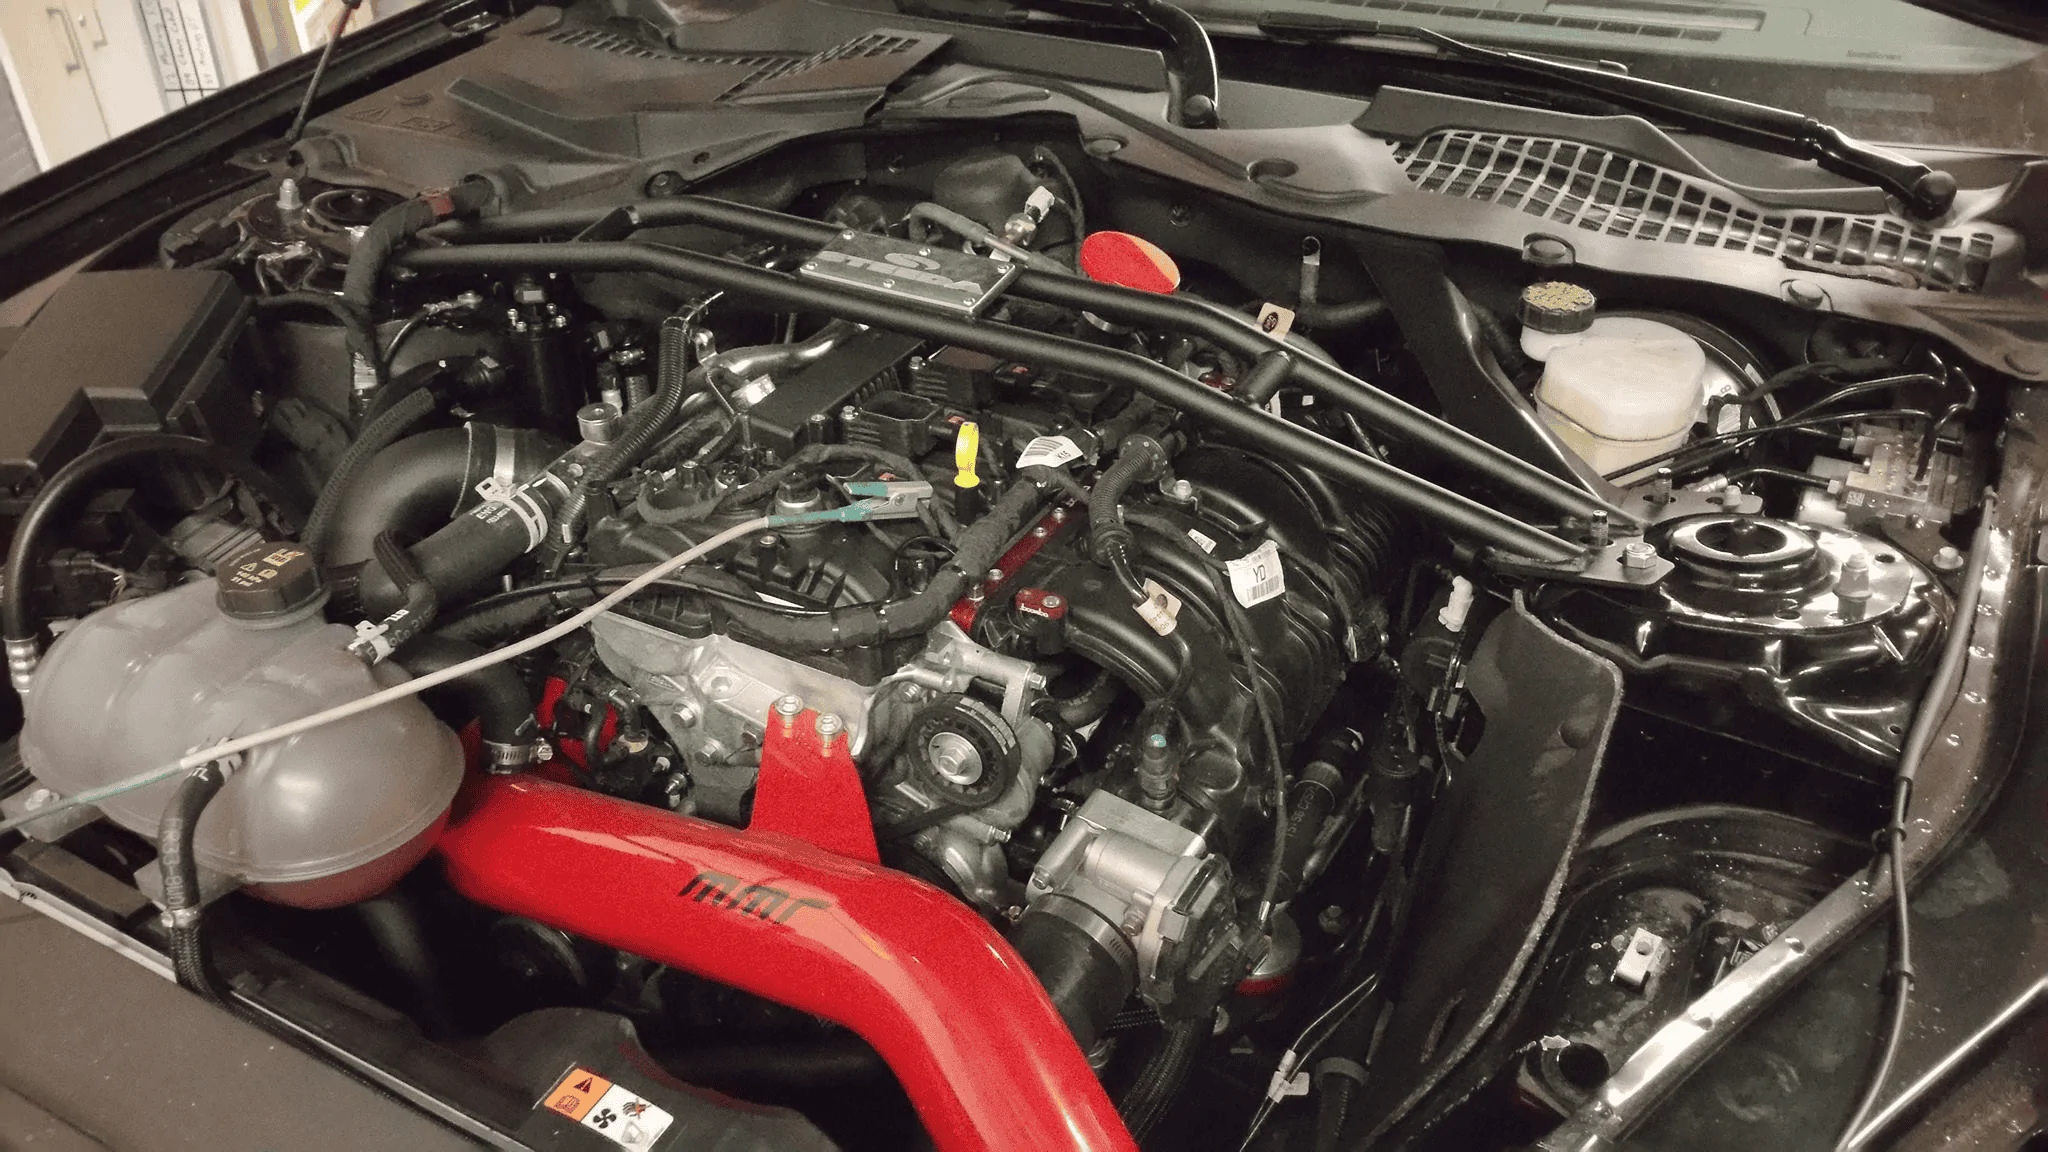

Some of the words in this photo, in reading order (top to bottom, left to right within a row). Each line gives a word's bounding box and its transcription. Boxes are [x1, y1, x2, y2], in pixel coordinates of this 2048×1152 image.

[816, 250, 983, 295] STEEDA
[1252, 562, 1268, 583] YD
[678, 870, 832, 925] mmr
